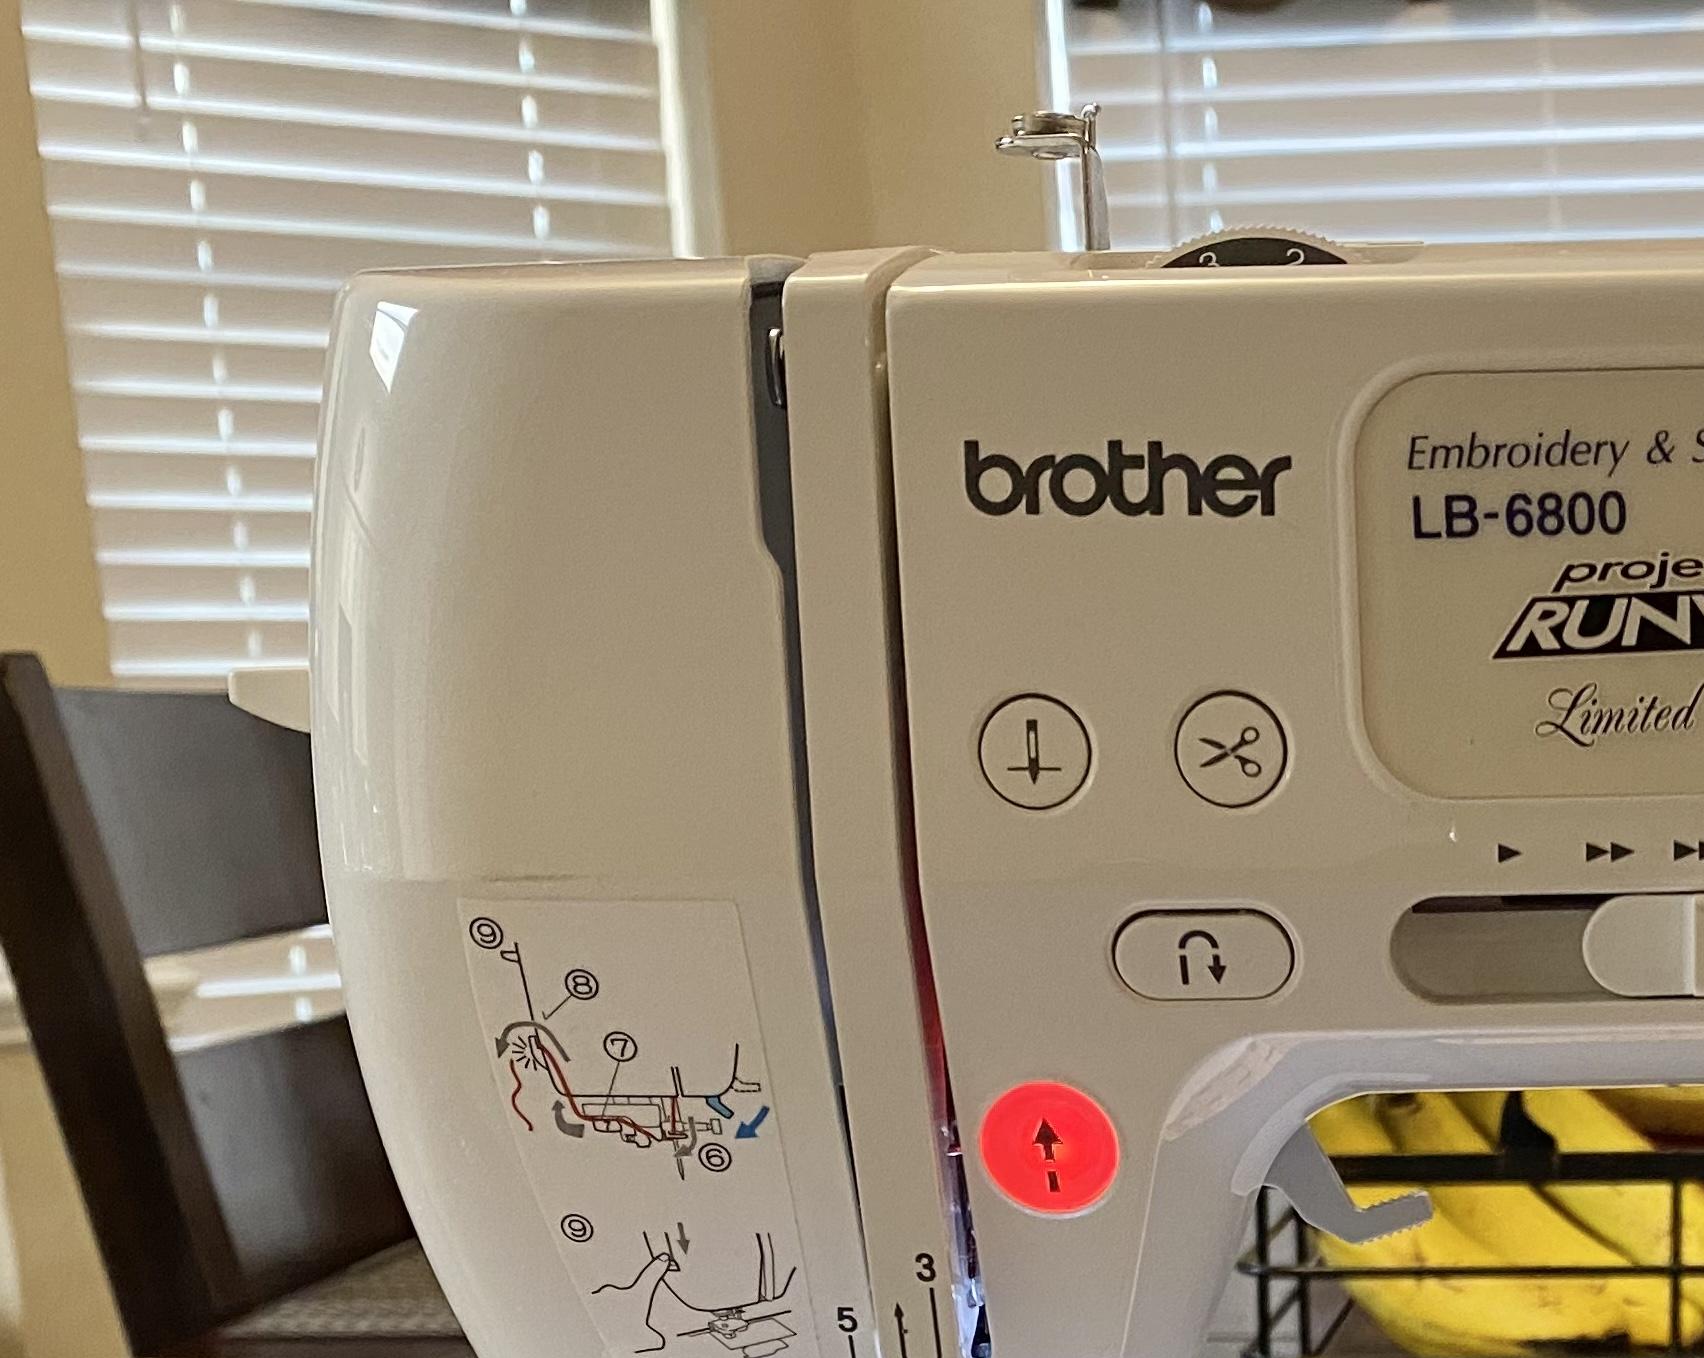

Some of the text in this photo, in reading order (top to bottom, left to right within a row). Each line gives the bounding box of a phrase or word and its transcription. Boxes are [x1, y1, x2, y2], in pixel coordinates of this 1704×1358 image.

[1407, 428, 1631, 478] Embroidery
[1646, 429, 1676, 465] &
[963, 438, 1293, 519] brother
[1412, 490, 1627, 540] LB-6800
[915, 1252, 936, 1282] 3
[837, 1306, 858, 1333] 5
